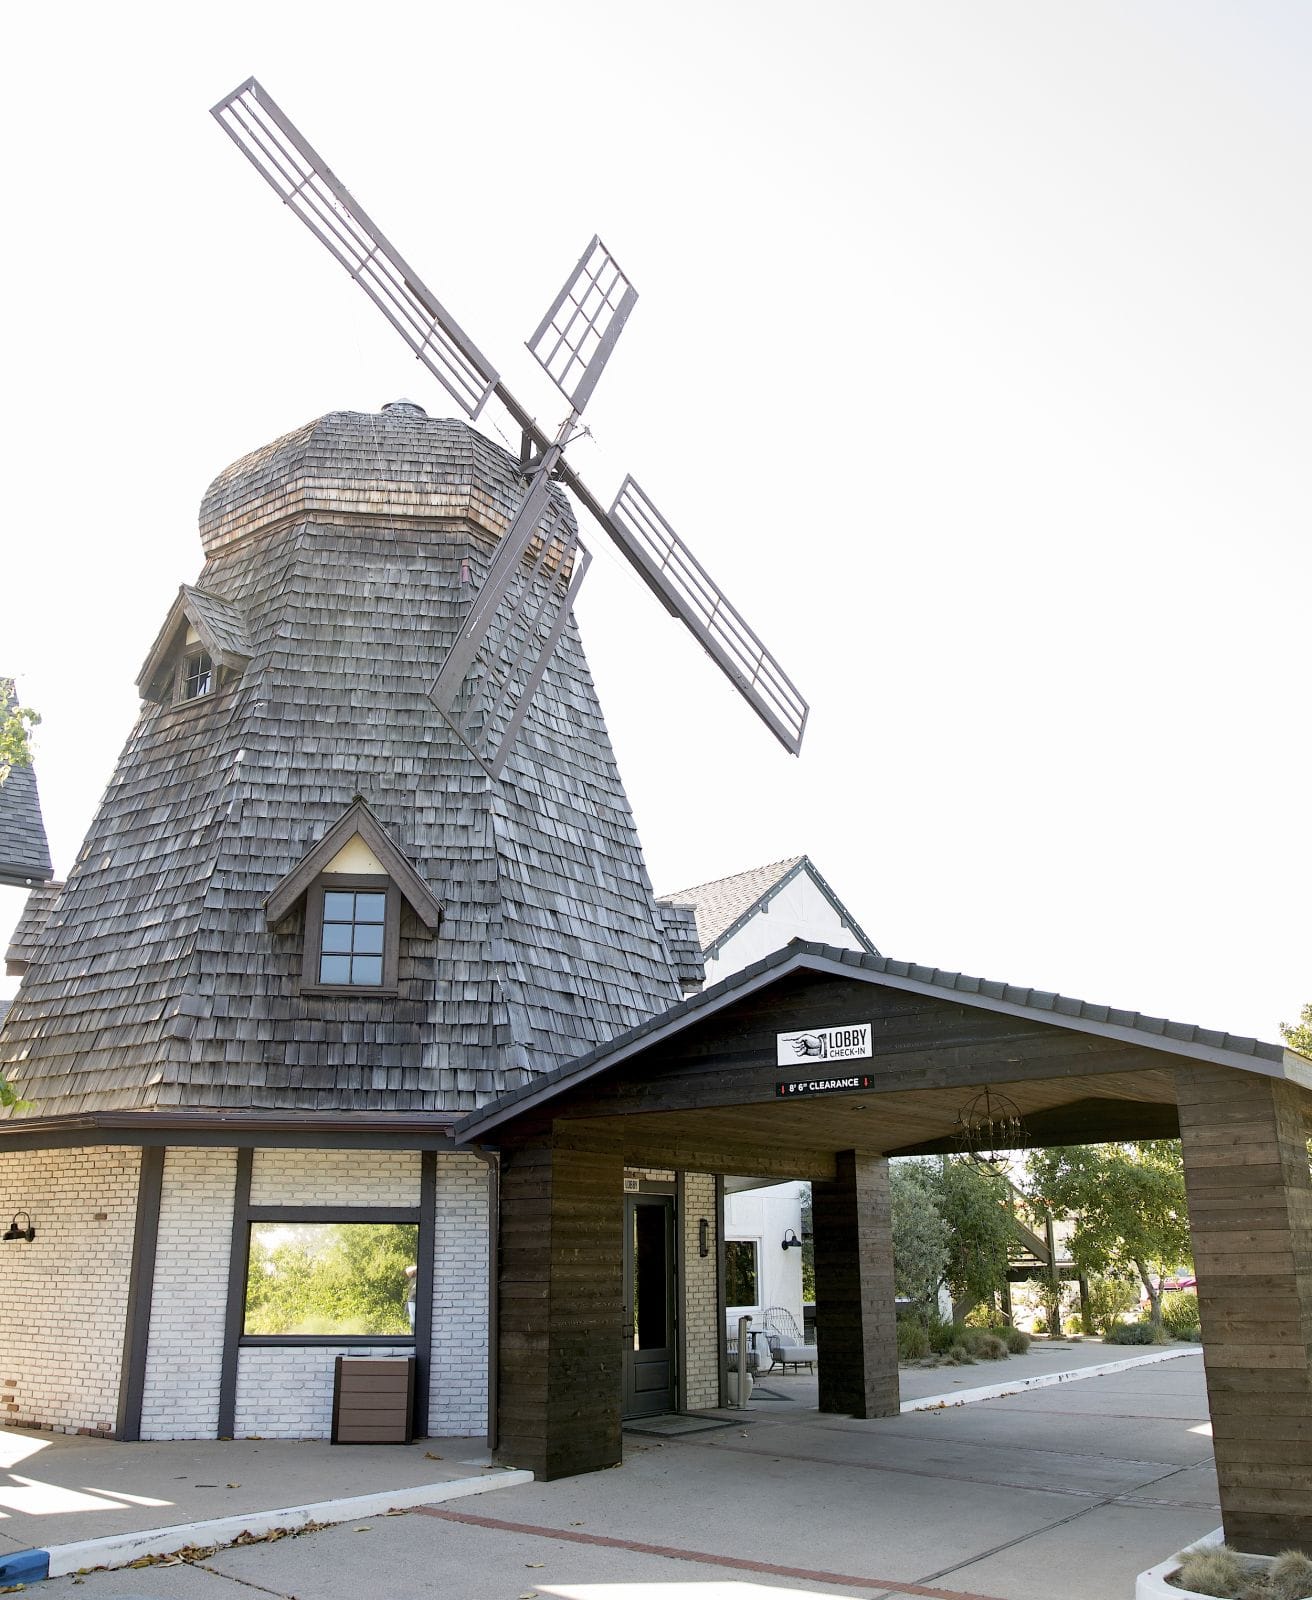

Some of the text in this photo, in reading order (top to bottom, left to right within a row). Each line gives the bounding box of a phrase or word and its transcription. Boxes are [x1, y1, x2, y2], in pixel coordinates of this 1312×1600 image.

[830, 1029, 867, 1048] LOBBY
[830, 1048, 865, 1057] CHECK-IN
[809, 1078, 859, 1090] CLEARANCE
